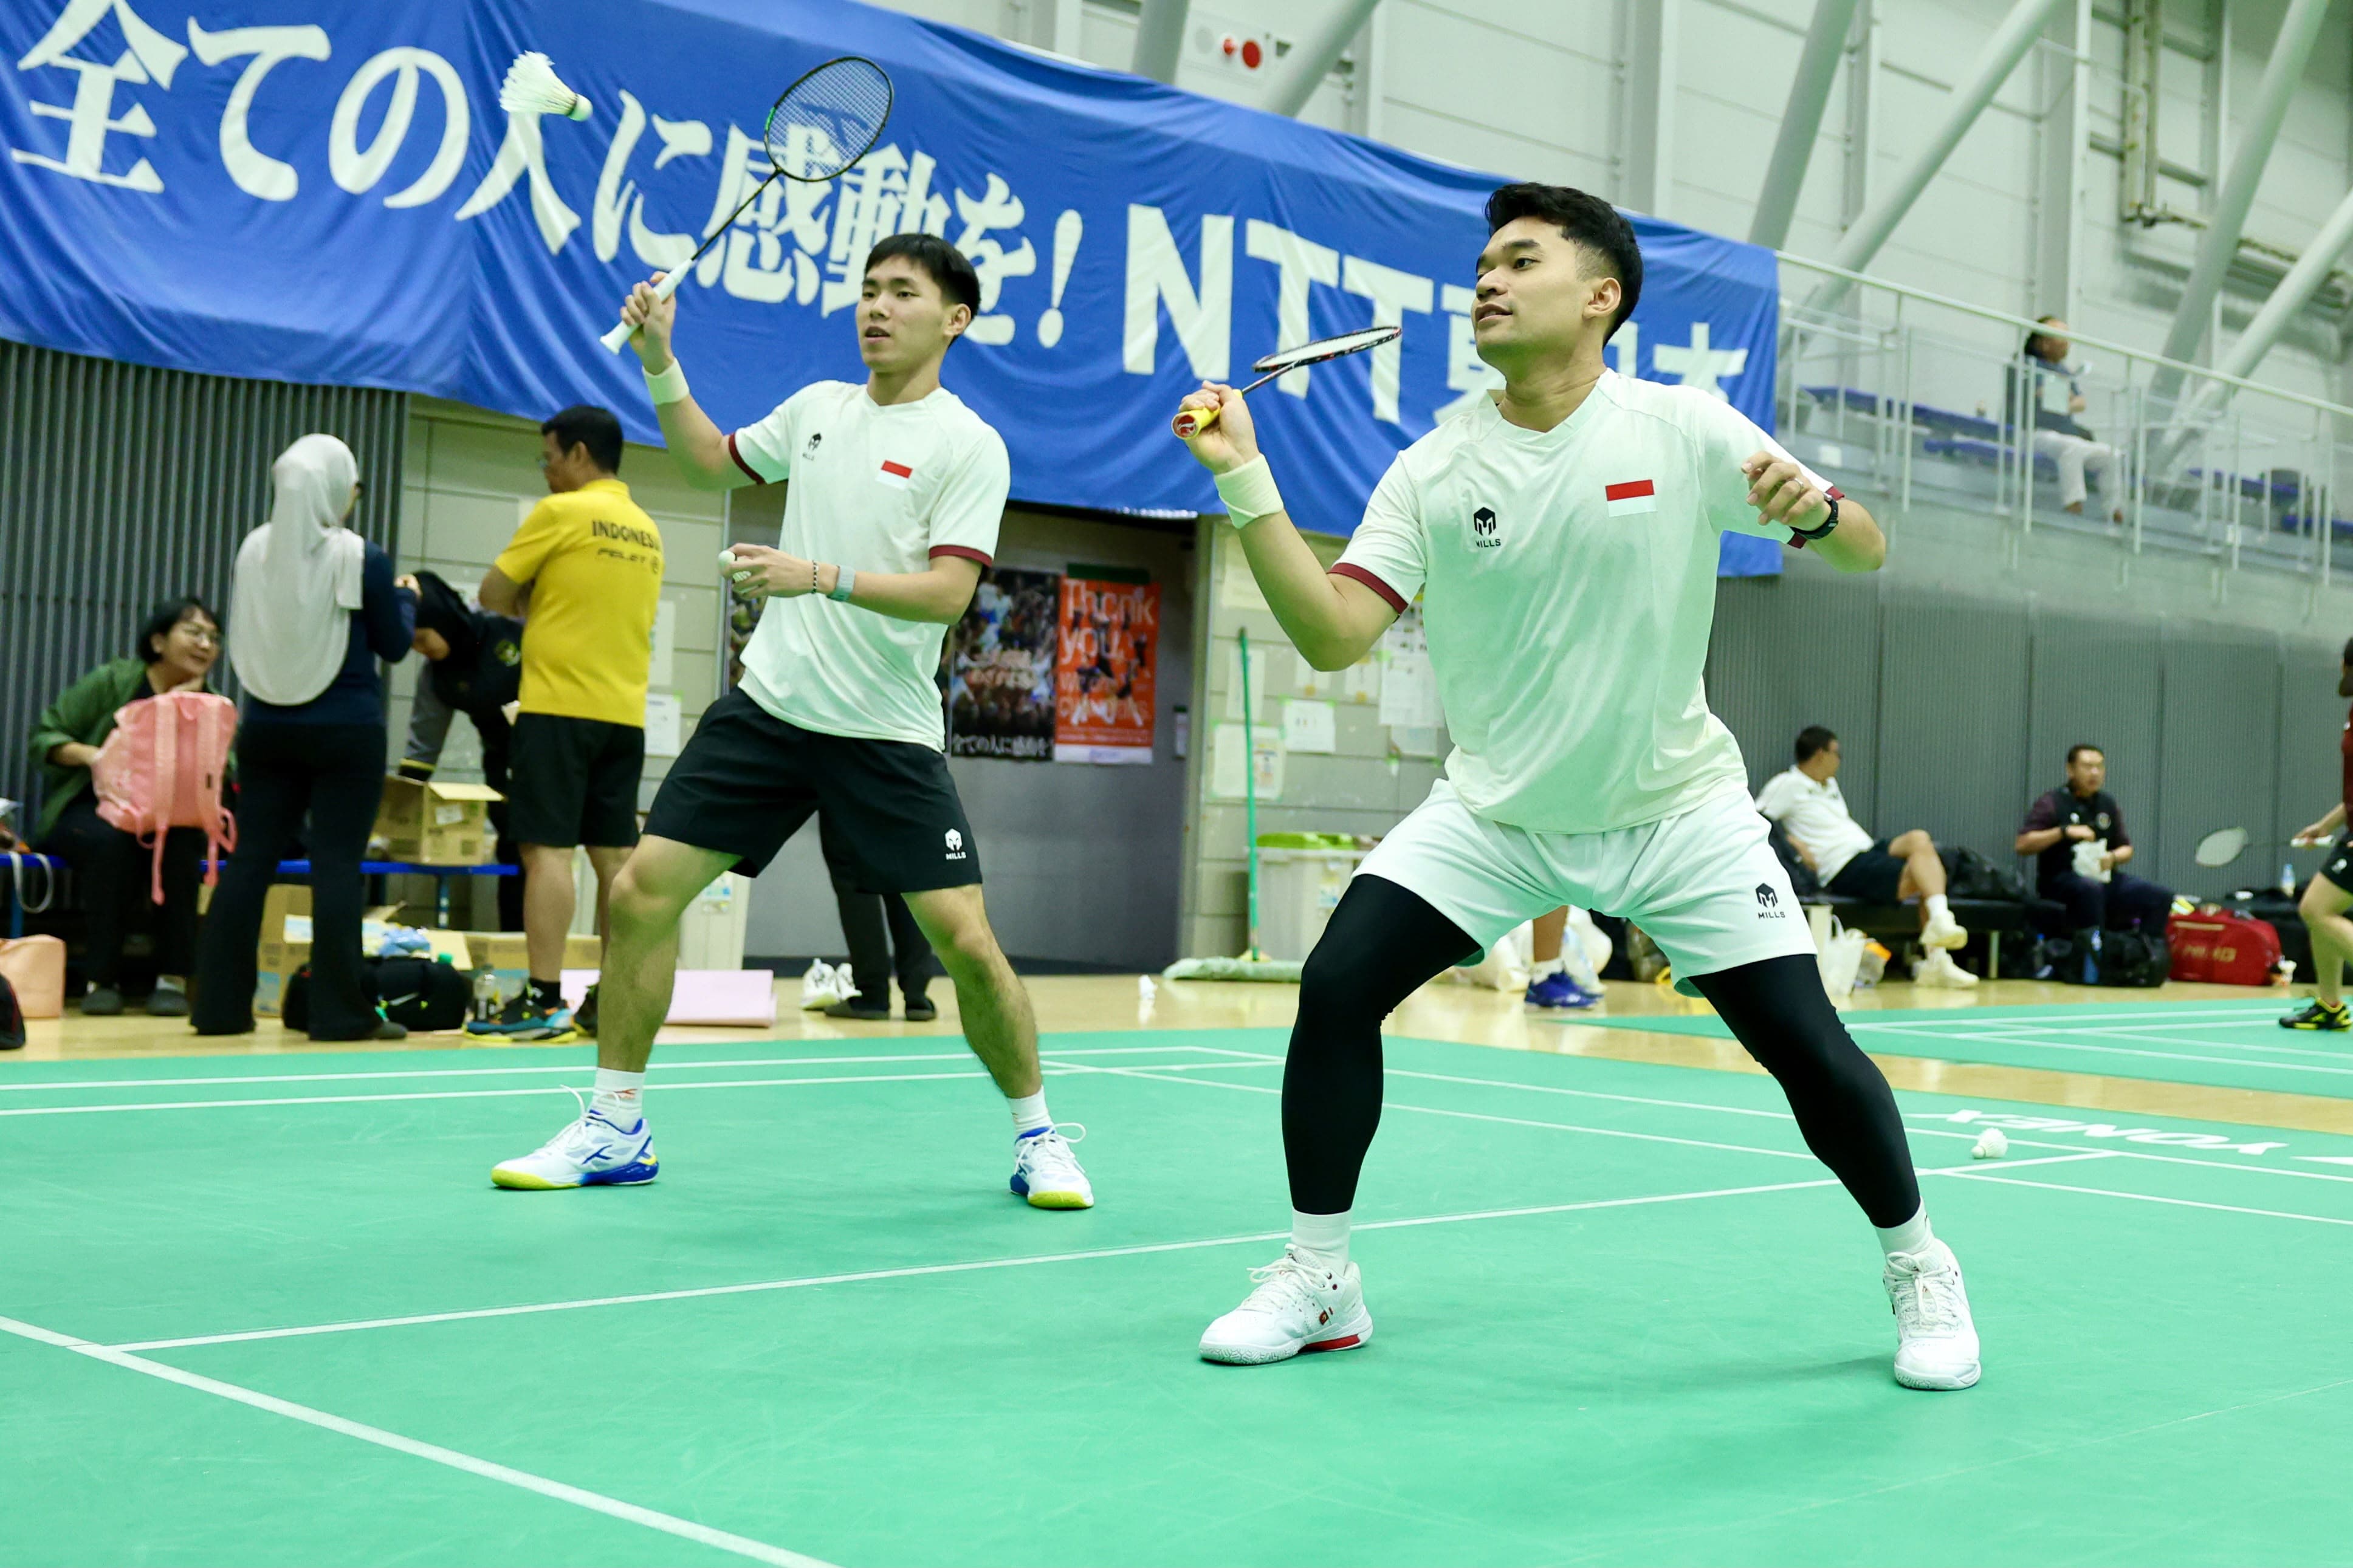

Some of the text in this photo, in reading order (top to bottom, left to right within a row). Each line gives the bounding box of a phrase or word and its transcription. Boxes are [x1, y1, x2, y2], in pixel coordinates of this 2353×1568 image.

[1122, 204, 1748, 426] NTT本
[592, 520, 661, 552] INDONES
[1475, 538, 1501, 548] MILLS
[946, 851, 966, 860] MILLS
[1902, 1109, 2289, 1155] YONEX
